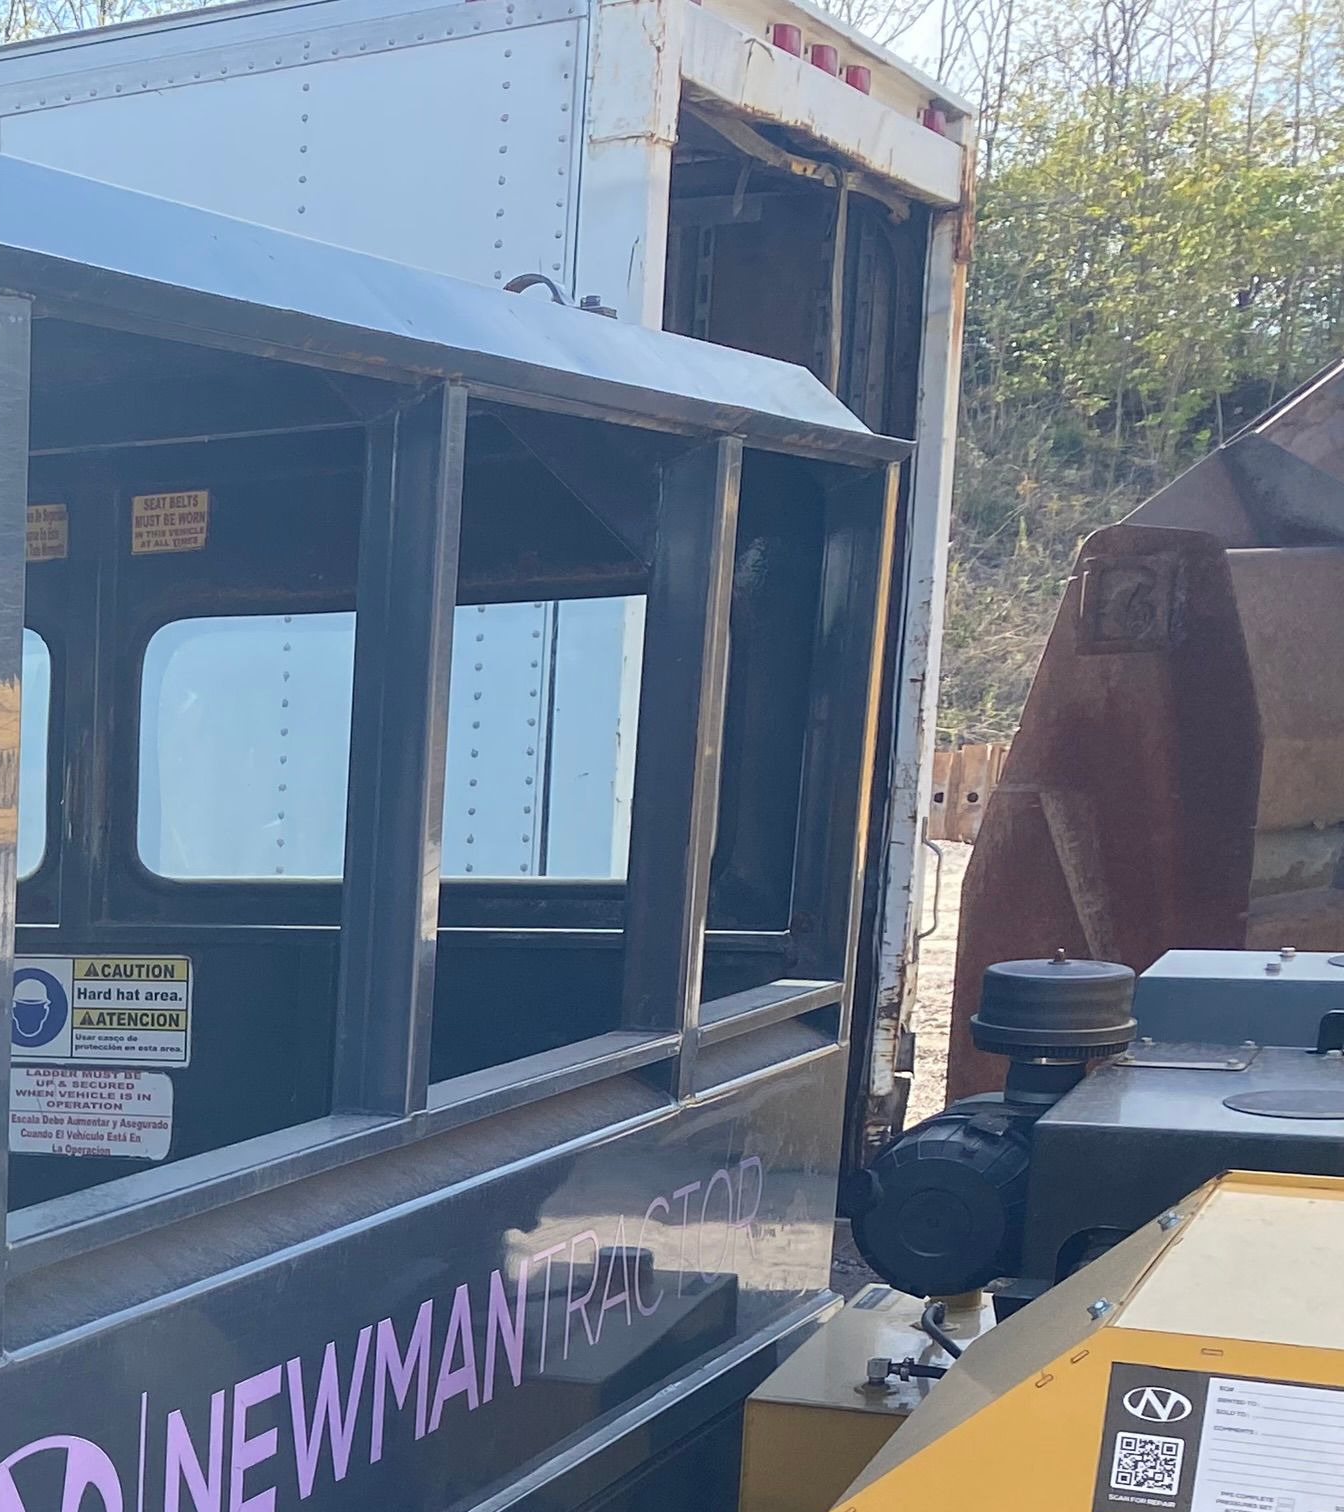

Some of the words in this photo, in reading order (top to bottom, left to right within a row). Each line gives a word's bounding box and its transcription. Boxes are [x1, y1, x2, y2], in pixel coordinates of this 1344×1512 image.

[144, 497, 167, 510] SEAT
[169, 495, 198, 509] BELTS
[135, 514, 161, 528] MUST
[163, 512, 176, 526] BE
[178, 511, 205, 525] WORN
[145, 530, 166, 538] THIS
[169, 526, 204, 537] VEHICLE
[140, 540, 151, 548] AT
[153, 539, 169, 547] ALL
[172, 536, 198, 547] TIMES
[101, 964, 175, 979] CAUTION
[77, 988, 112, 1000] Hard
[116, 988, 140, 1001] hat
[145, 991, 183, 1002] area.
[96, 1012, 180, 1027] ATENCION
[75, 1033, 95, 1041] Usar
[127, 1034, 138, 1042] de
[26, 1069, 77, 1078] LADDER
[82, 1070, 117, 1079] MUST
[124, 1072, 141, 1080] BE
[72, 1081, 135, 1090] SECURED
[15, 1089, 54, 1097] WHEN
[58, 1091, 115, 1100] VEHICLE
[120, 1092, 132, 1100] IS
[137, 1093, 151, 1101] IN
[47, 1101, 123, 1110] OPERATION
[11, 1114, 40, 1124] Escala
[67, 1116, 110, 1126] Aumentar
[120, 1118, 168, 1131] Asegurado
[20, 1129, 53, 1138] Cuando
[55, 1129, 64, 1139] El
[130, 1133, 141, 1143] En
[52, 1143, 63, 1153] La
[1108, 1493, 1130, 1502] SCAN
[1130, 1496, 1146, 1505] FOR
[1147, 1498, 1176, 1508] REPAIR
